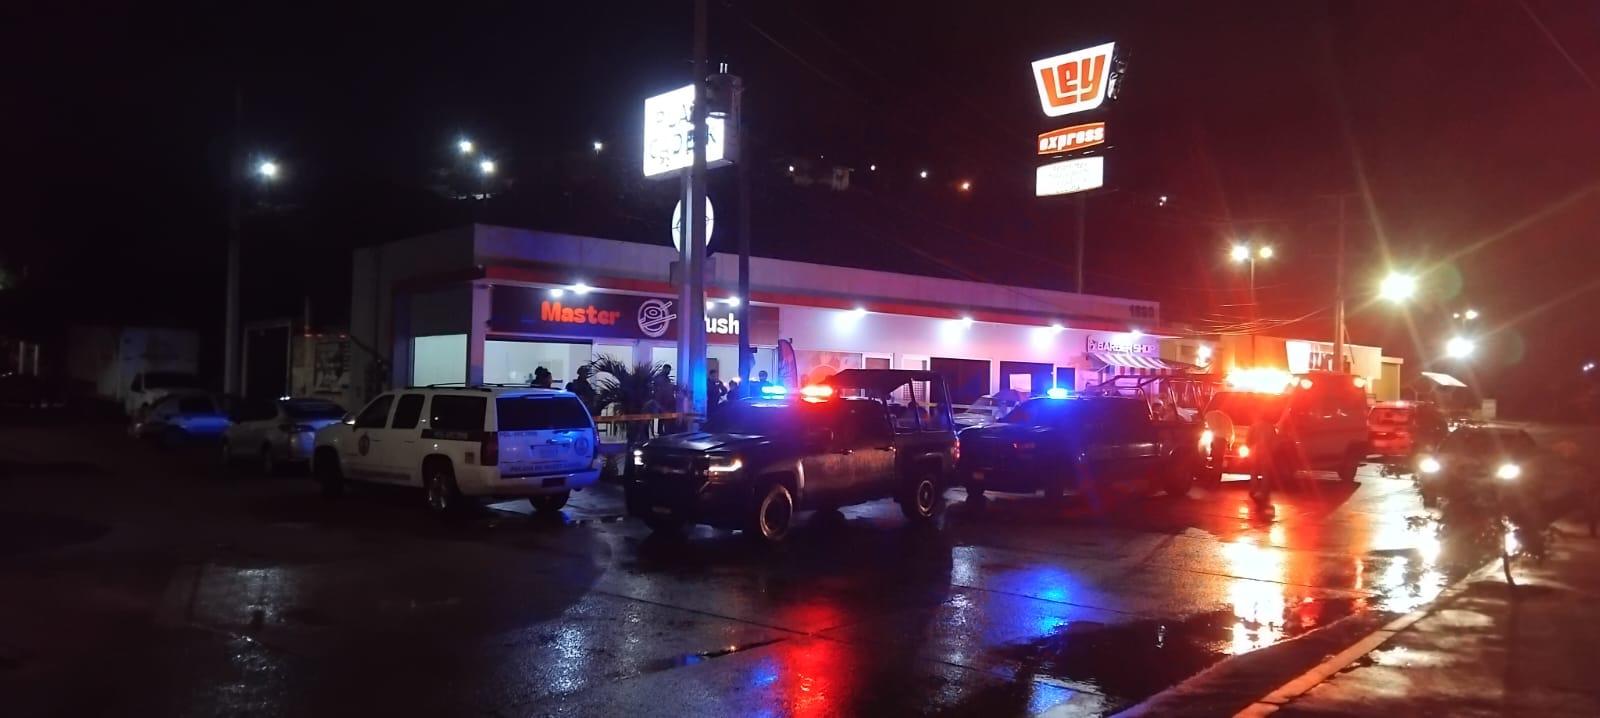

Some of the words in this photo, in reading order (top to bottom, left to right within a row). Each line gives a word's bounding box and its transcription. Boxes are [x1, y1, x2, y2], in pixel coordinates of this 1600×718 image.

[1041, 54, 1105, 107] Ley
[1040, 127, 1104, 151] express
[541, 300, 621, 326] Master
[705, 312, 740, 334] ush
[1133, 344, 1156, 354] SHOP
